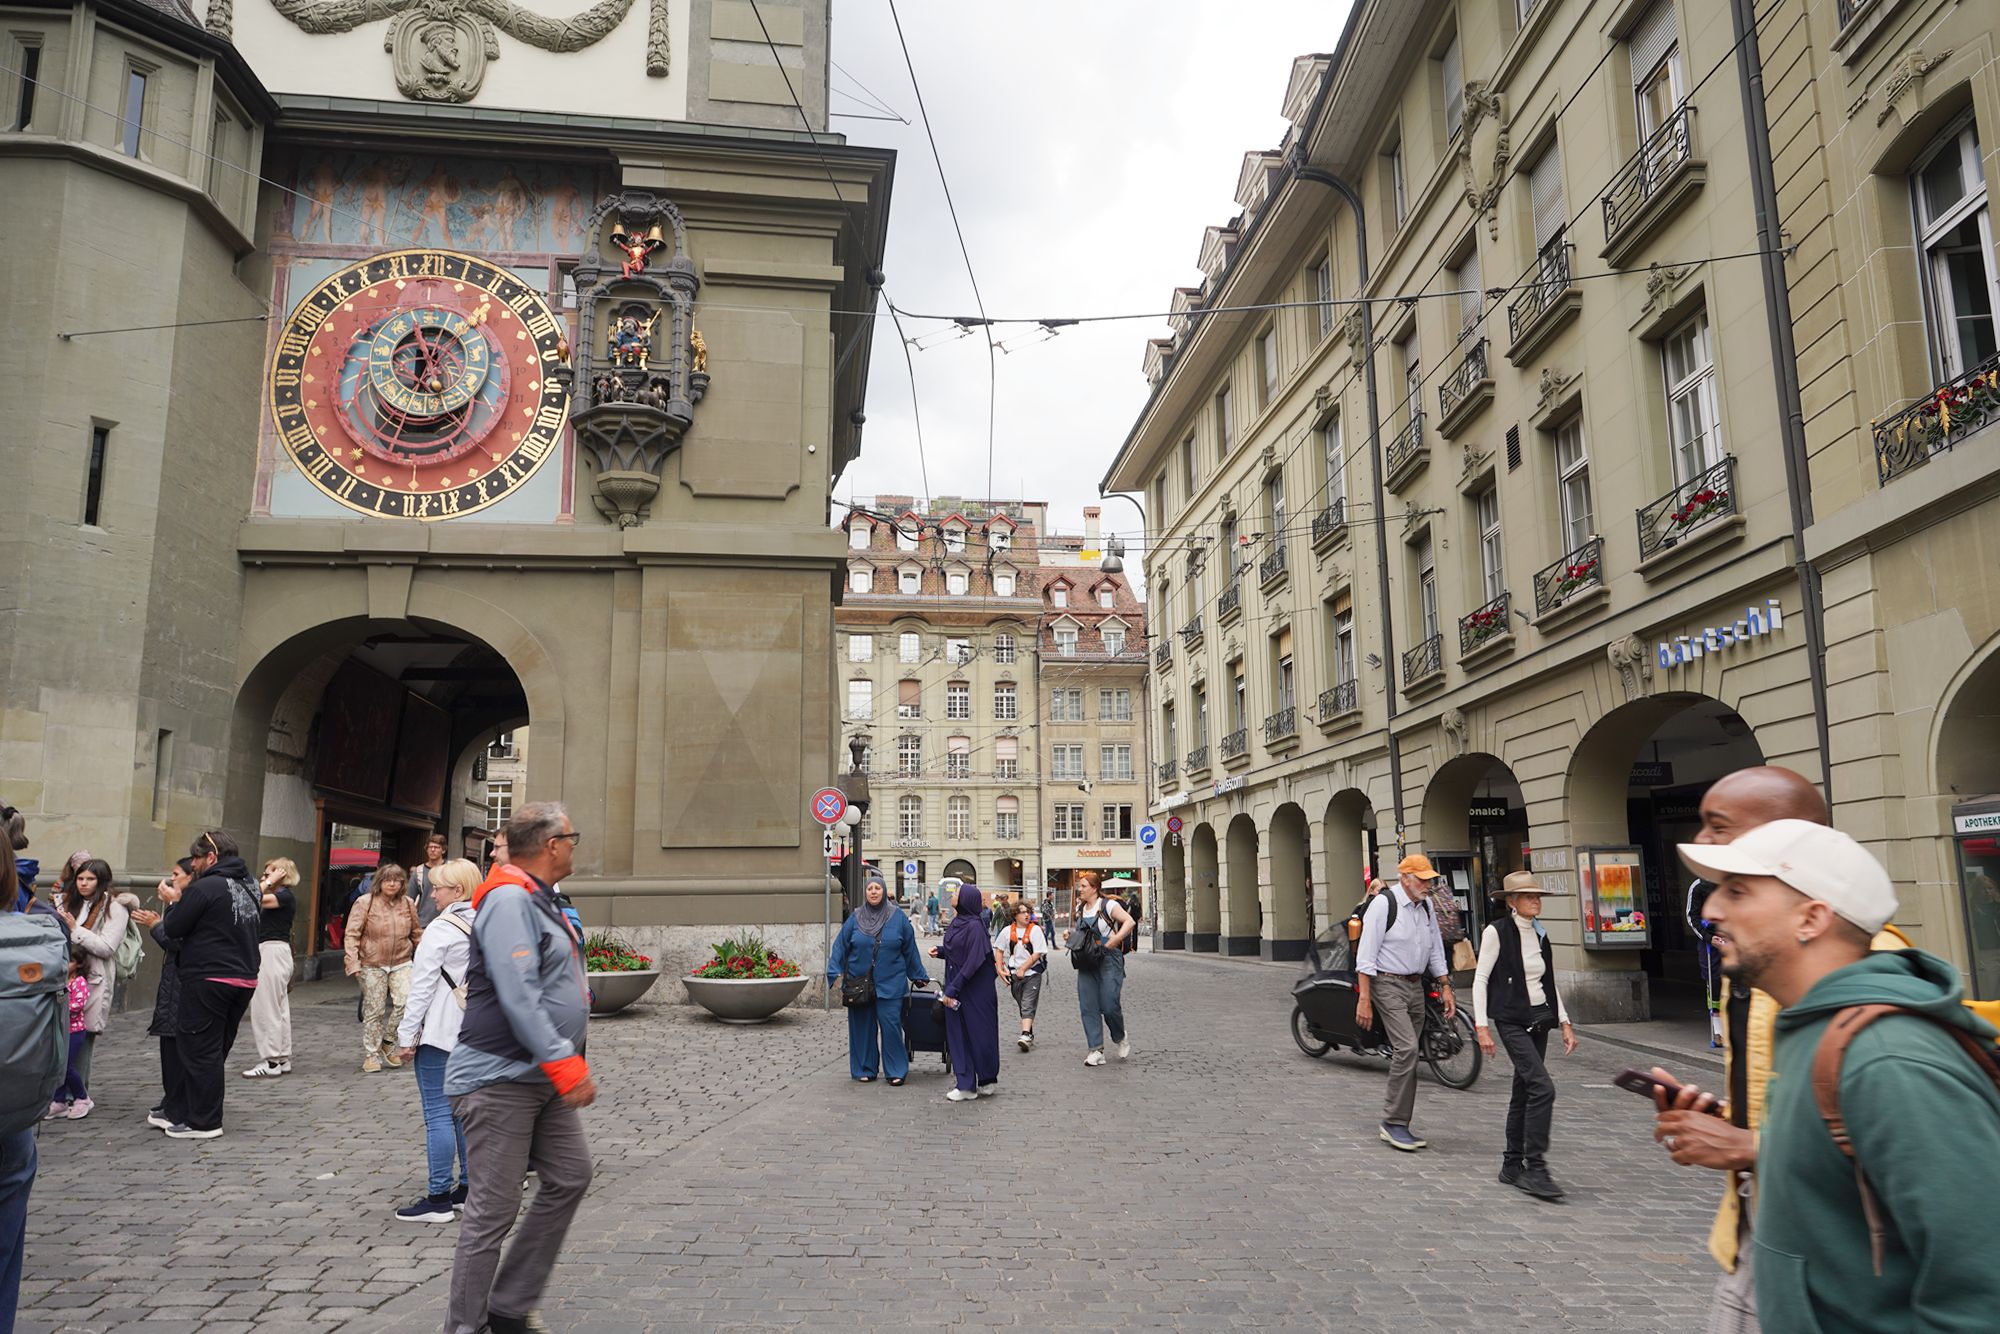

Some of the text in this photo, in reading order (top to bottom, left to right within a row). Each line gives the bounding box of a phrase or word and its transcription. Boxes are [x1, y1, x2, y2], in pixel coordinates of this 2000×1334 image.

[1218, 776, 1243, 794] swisscom
[1469, 807, 1506, 816] onald's
[890, 840, 931, 848] BUCHERER
[1077, 848, 1112, 858] Nomad
